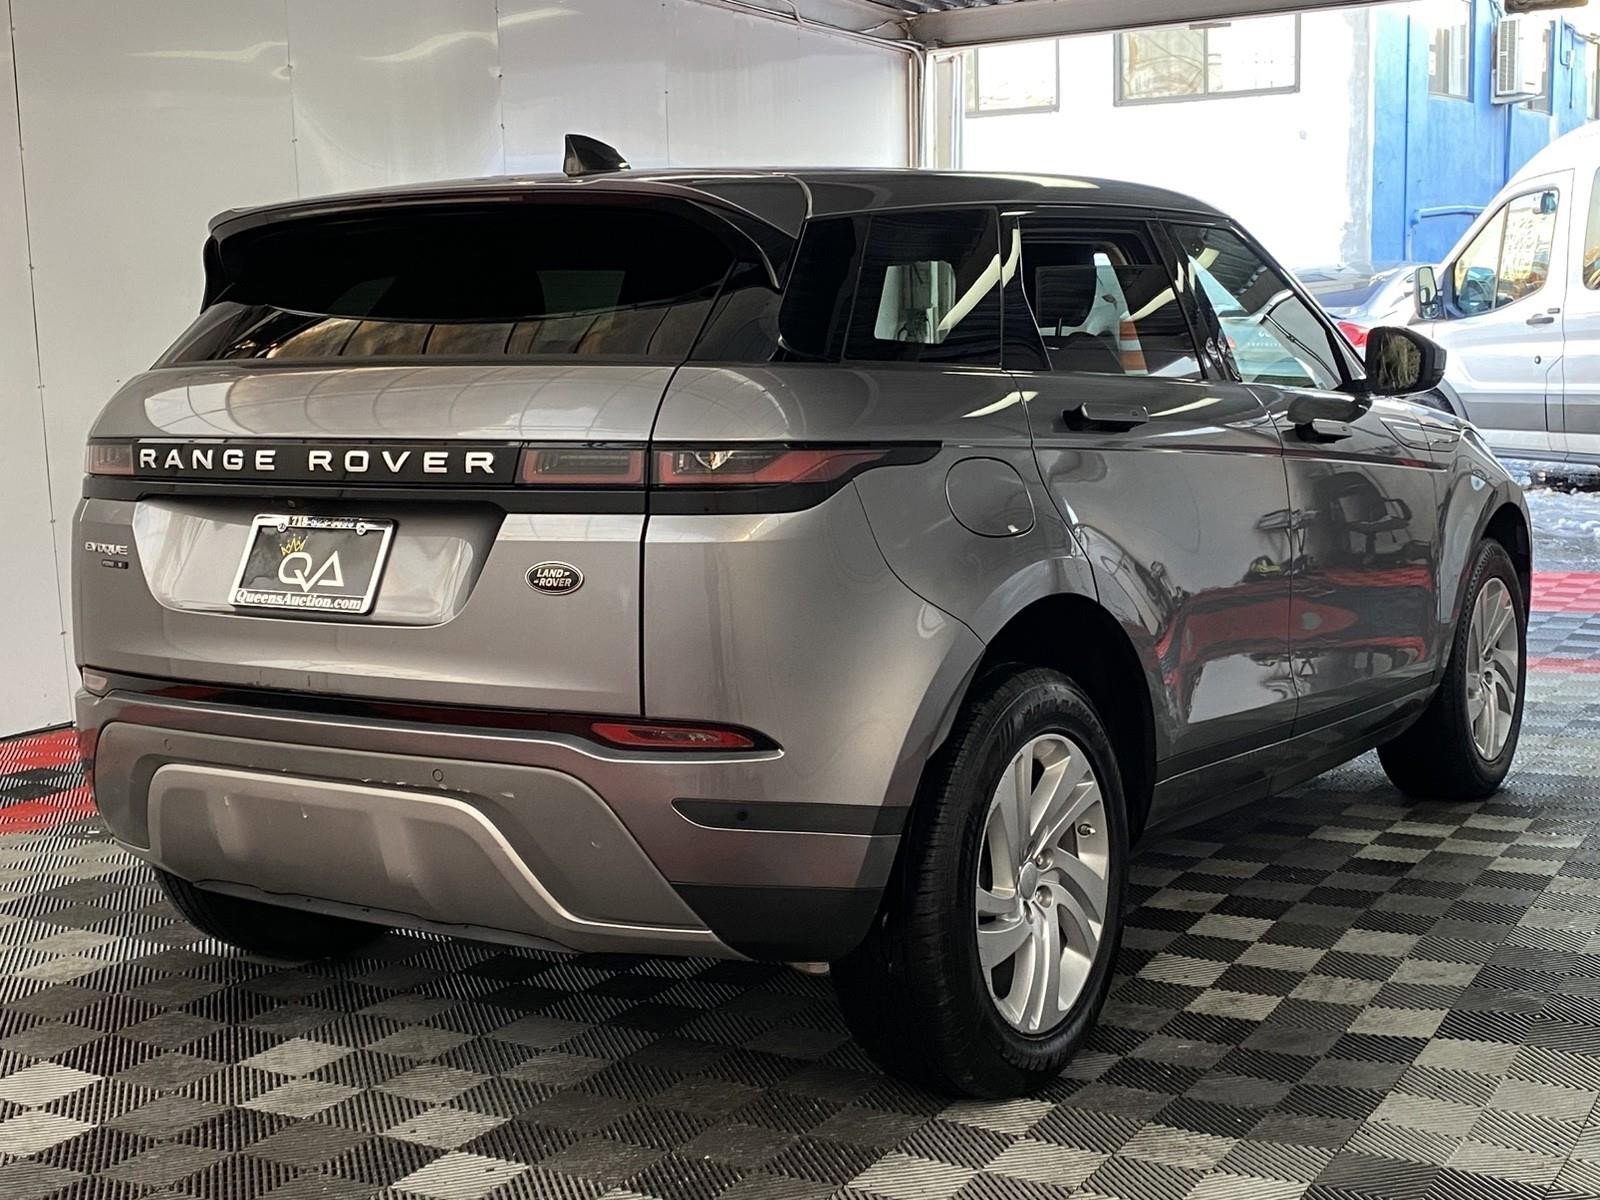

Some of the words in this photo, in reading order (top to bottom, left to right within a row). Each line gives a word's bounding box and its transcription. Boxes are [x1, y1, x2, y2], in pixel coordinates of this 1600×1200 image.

[139, 448, 276, 471] RANGE
[308, 450, 495, 475] ROVER
[85, 541, 128, 555] EVOQUE
[278, 550, 344, 592] QA
[536, 568, 564, 578] LAND
[538, 577, 572, 587] ROVER
[236, 588, 362, 610] QueensAuction.com
